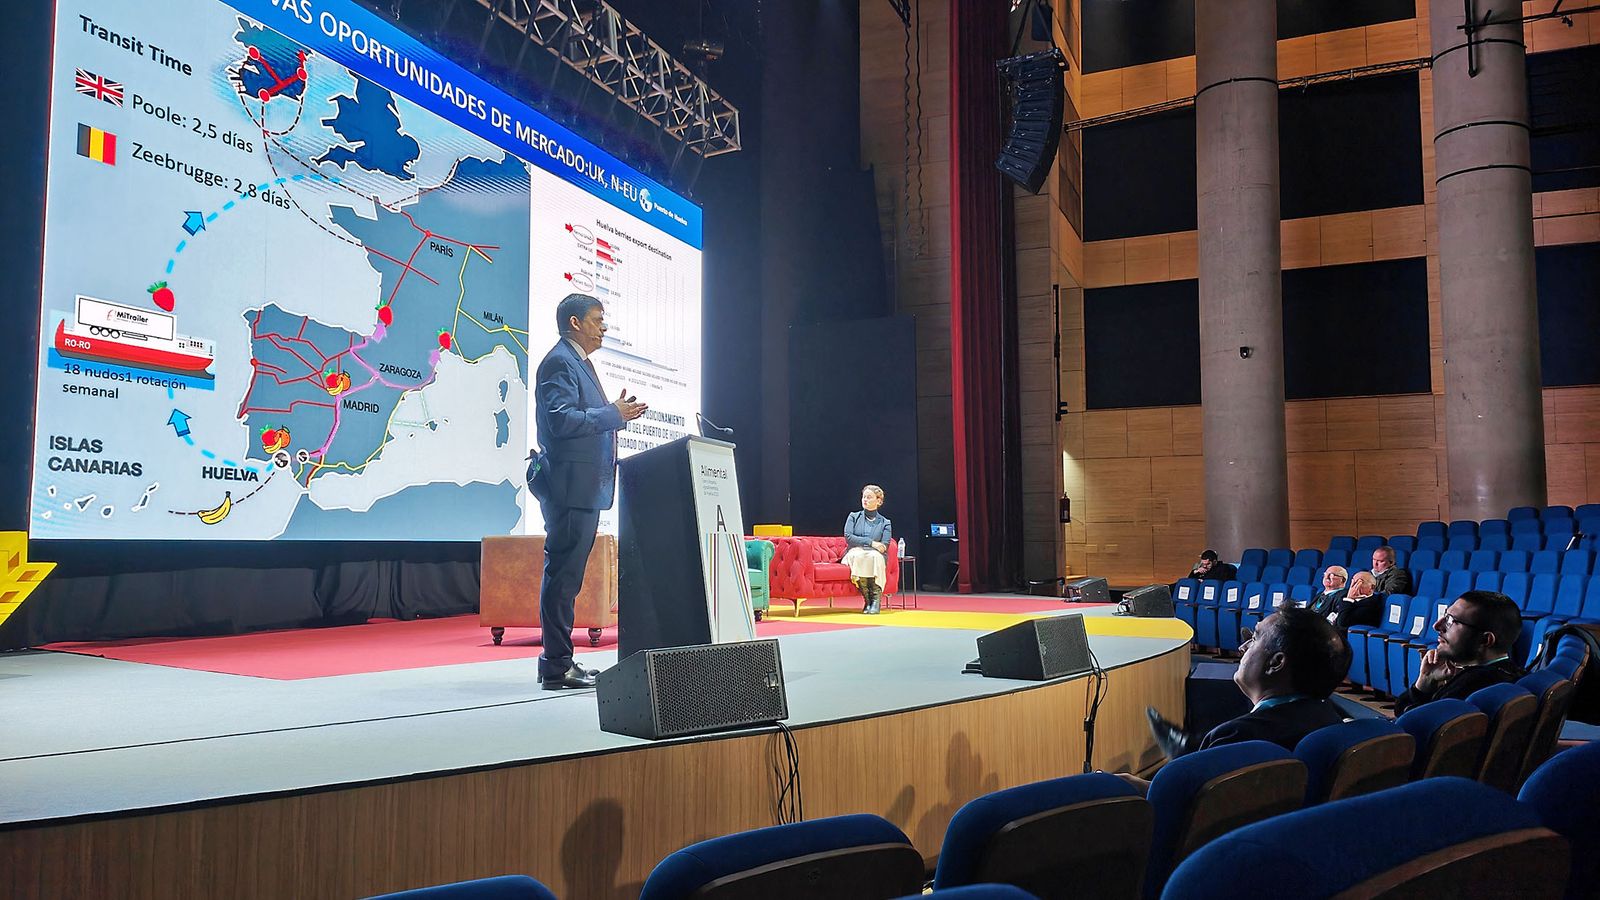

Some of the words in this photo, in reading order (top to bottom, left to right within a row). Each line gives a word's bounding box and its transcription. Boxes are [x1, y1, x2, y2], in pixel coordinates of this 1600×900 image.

[79, 14, 144, 56] Transit
[149, 44, 192, 76] Time
[272, 0, 313, 23] AS
[320, 11, 486, 120] OPORTUNIDADES
[491, 107, 512, 134] DE
[611, 174, 638, 202] N-EU
[132, 94, 187, 128] Poole:
[192, 117, 217, 139] 2,5
[222, 131, 253, 153] días
[132, 142, 228, 189] Zeebrugge:
[233, 179, 257, 198] 2,8
[261, 187, 291, 209] días
[596, 219, 614, 234] Huelva
[614, 227, 632, 242] berries
[632, 237, 647, 249] export
[647, 242, 672, 261] destination
[430, 241, 454, 258] PARÍS
[116, 311, 149, 324] MiTrailer
[483, 311, 504, 324] MILÁN
[64, 338, 91, 350] RO-RO
[63, 363, 81, 375] 18
[85, 368, 132, 383] nudos1
[136, 375, 187, 390] rotación
[379, 362, 422, 380] ZARAGOZA
[62, 383, 119, 399] semanal
[343, 399, 380, 413] MADRID
[642, 424, 662, 438] PUERTO
[49, 435, 103, 454] ISLAS
[48, 457, 143, 477] CANARIAS
[202, 467, 258, 482] HUELVA
